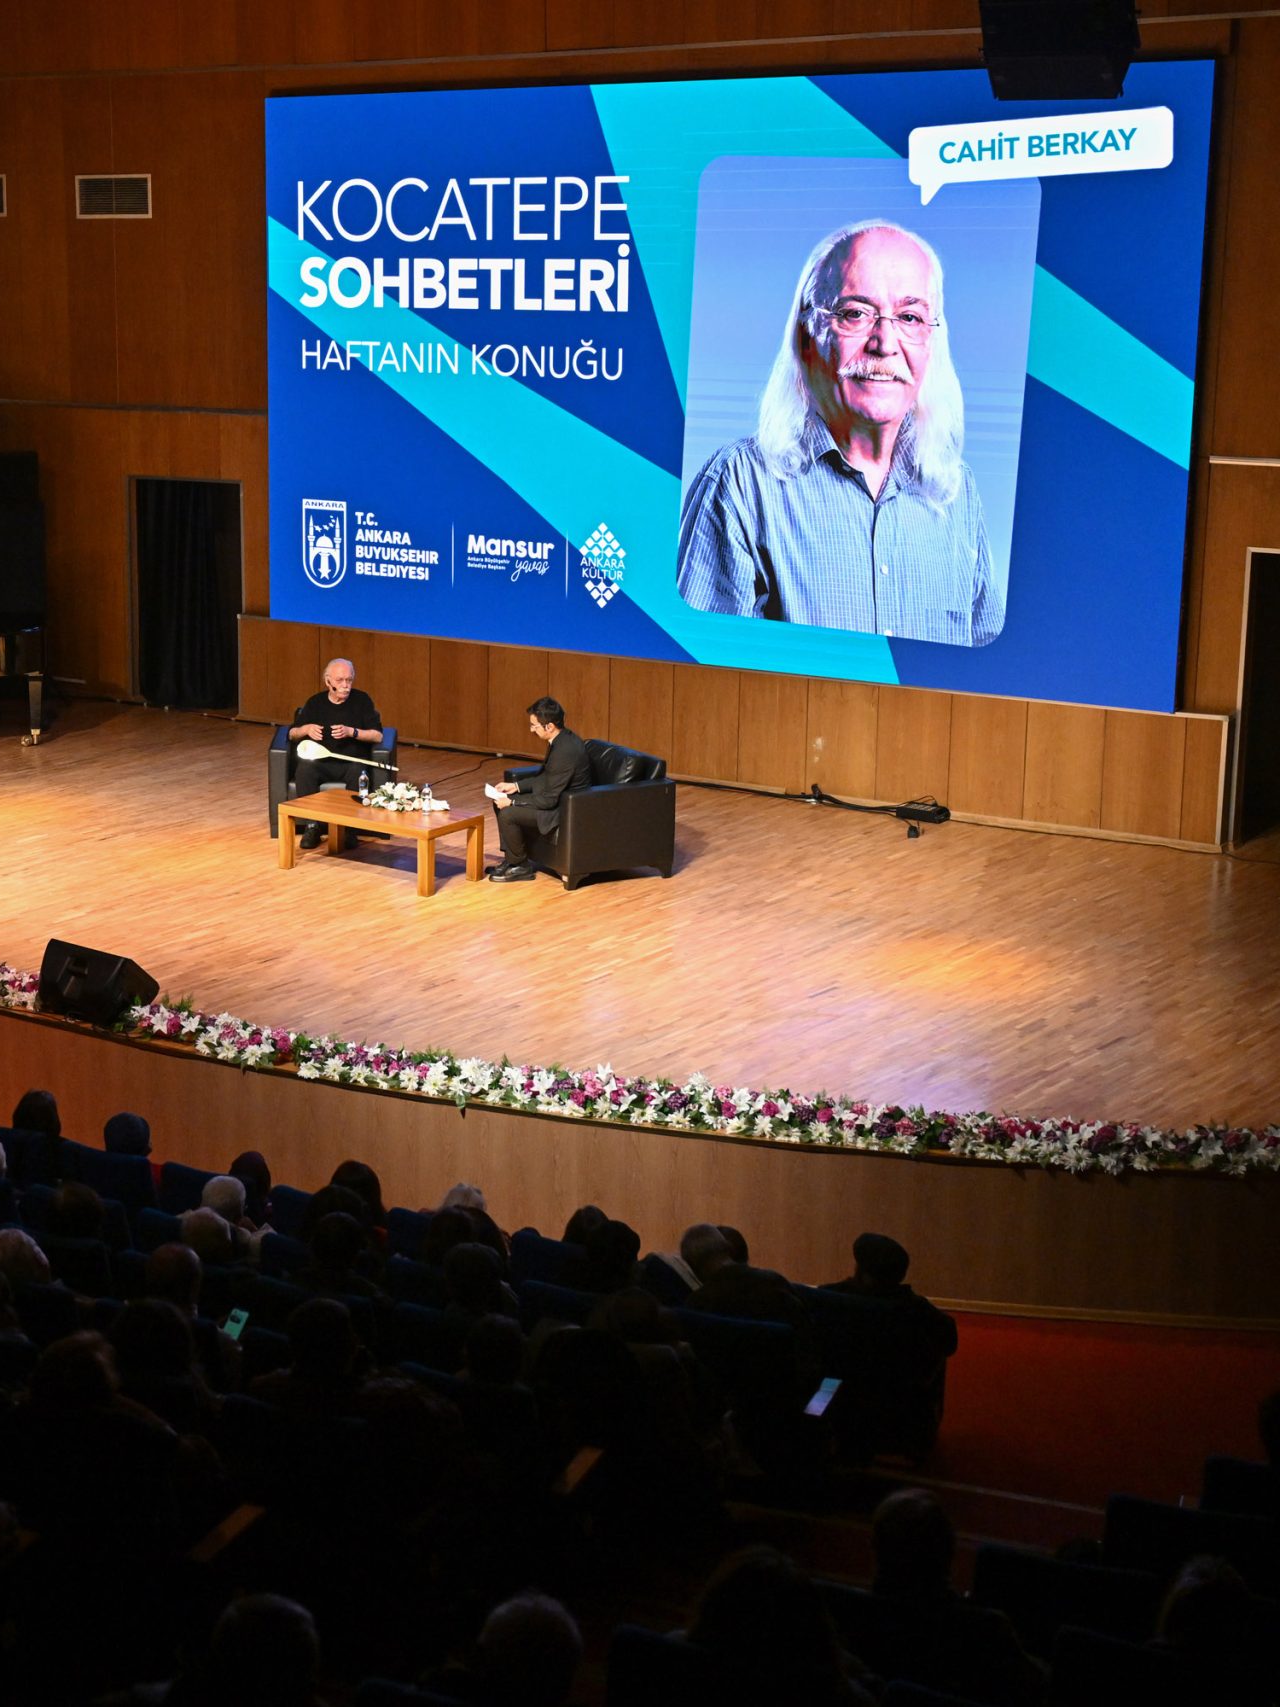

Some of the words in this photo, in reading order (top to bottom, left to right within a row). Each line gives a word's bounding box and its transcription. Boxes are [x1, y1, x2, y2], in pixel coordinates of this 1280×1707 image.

[938, 131, 1020, 164] CAHİT
[1027, 127, 1138, 158] BERKAY
[296, 175, 630, 242] KOCATEPE
[298, 243, 630, 312] SOHBETLERİ
[301, 339, 459, 375] HAFTANIN
[471, 338, 624, 381] KONUĞU
[305, 501, 344, 509] ANKARA
[355, 511, 379, 526] T.C.
[355, 528, 412, 545] ANKARA
[467, 534, 555, 559] Mansur
[580, 556, 625, 570] ANKARA
[581, 566, 624, 581] KÜLTÜR
